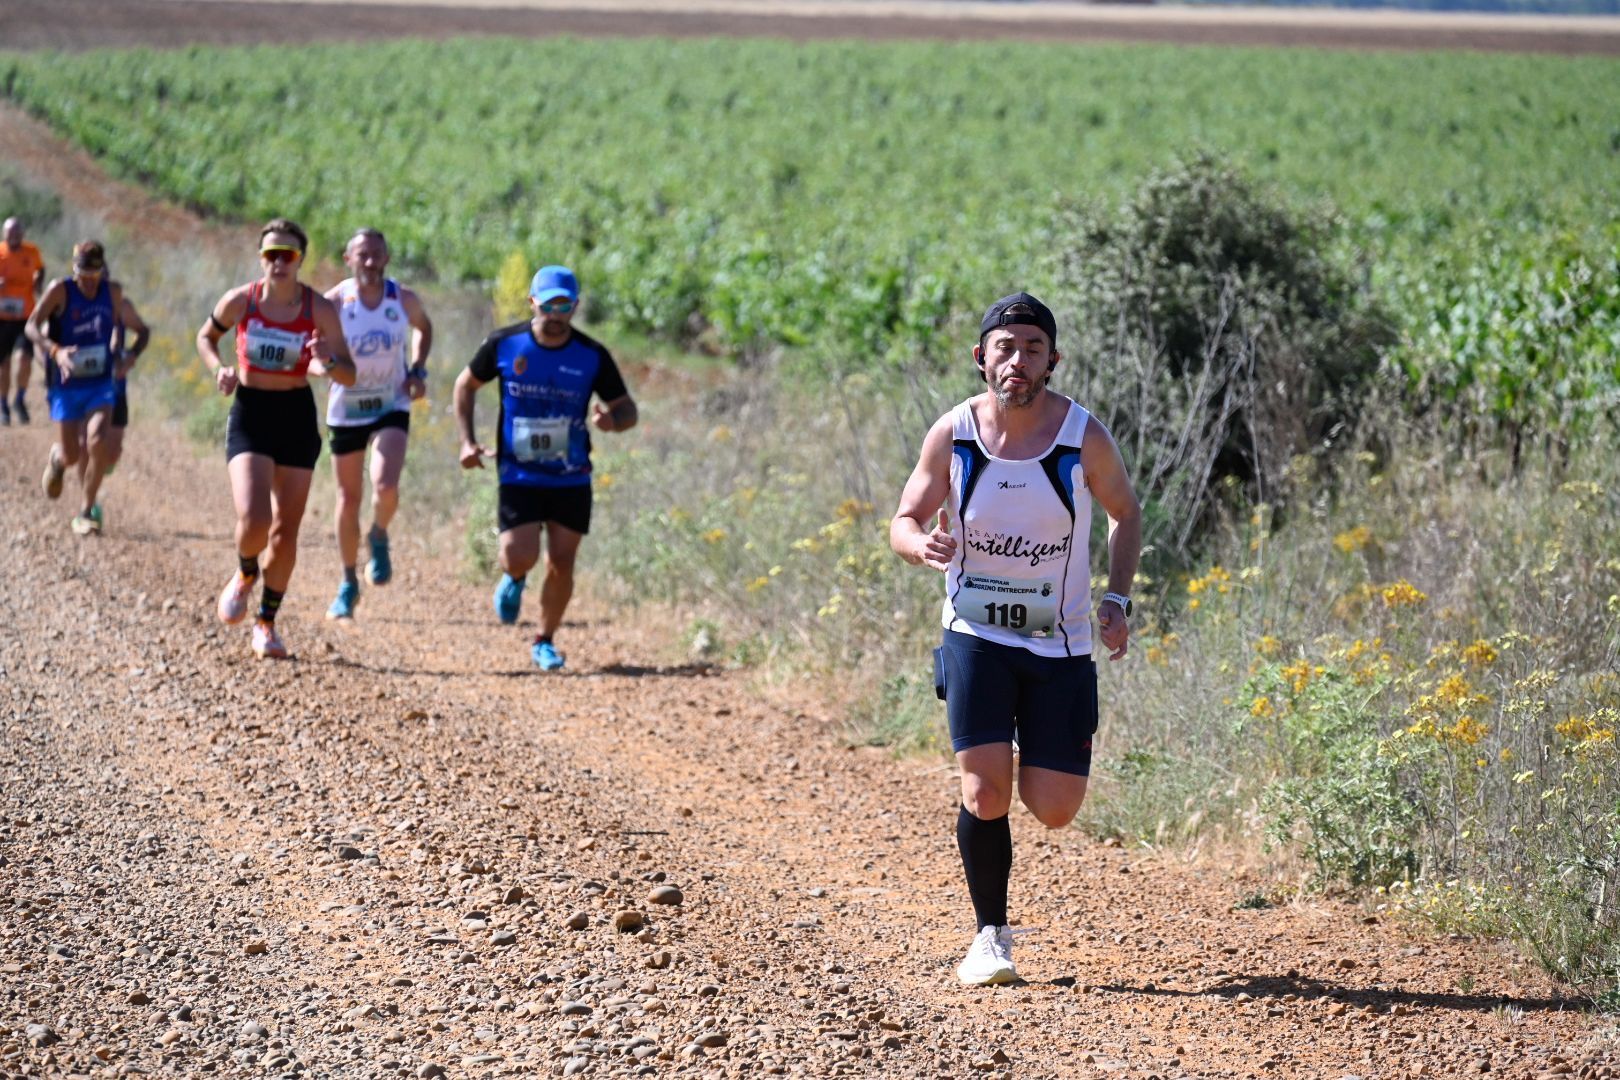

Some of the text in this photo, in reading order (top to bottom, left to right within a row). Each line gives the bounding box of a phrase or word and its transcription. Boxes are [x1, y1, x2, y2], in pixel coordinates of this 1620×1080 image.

[258, 343, 286, 363] 108
[530, 433, 551, 450] 89
[967, 526, 1005, 540] TEAM
[968, 533, 1070, 567] intelligent
[997, 586, 1037, 594] ENTRECEPAS
[984, 602, 1027, 629] 119
